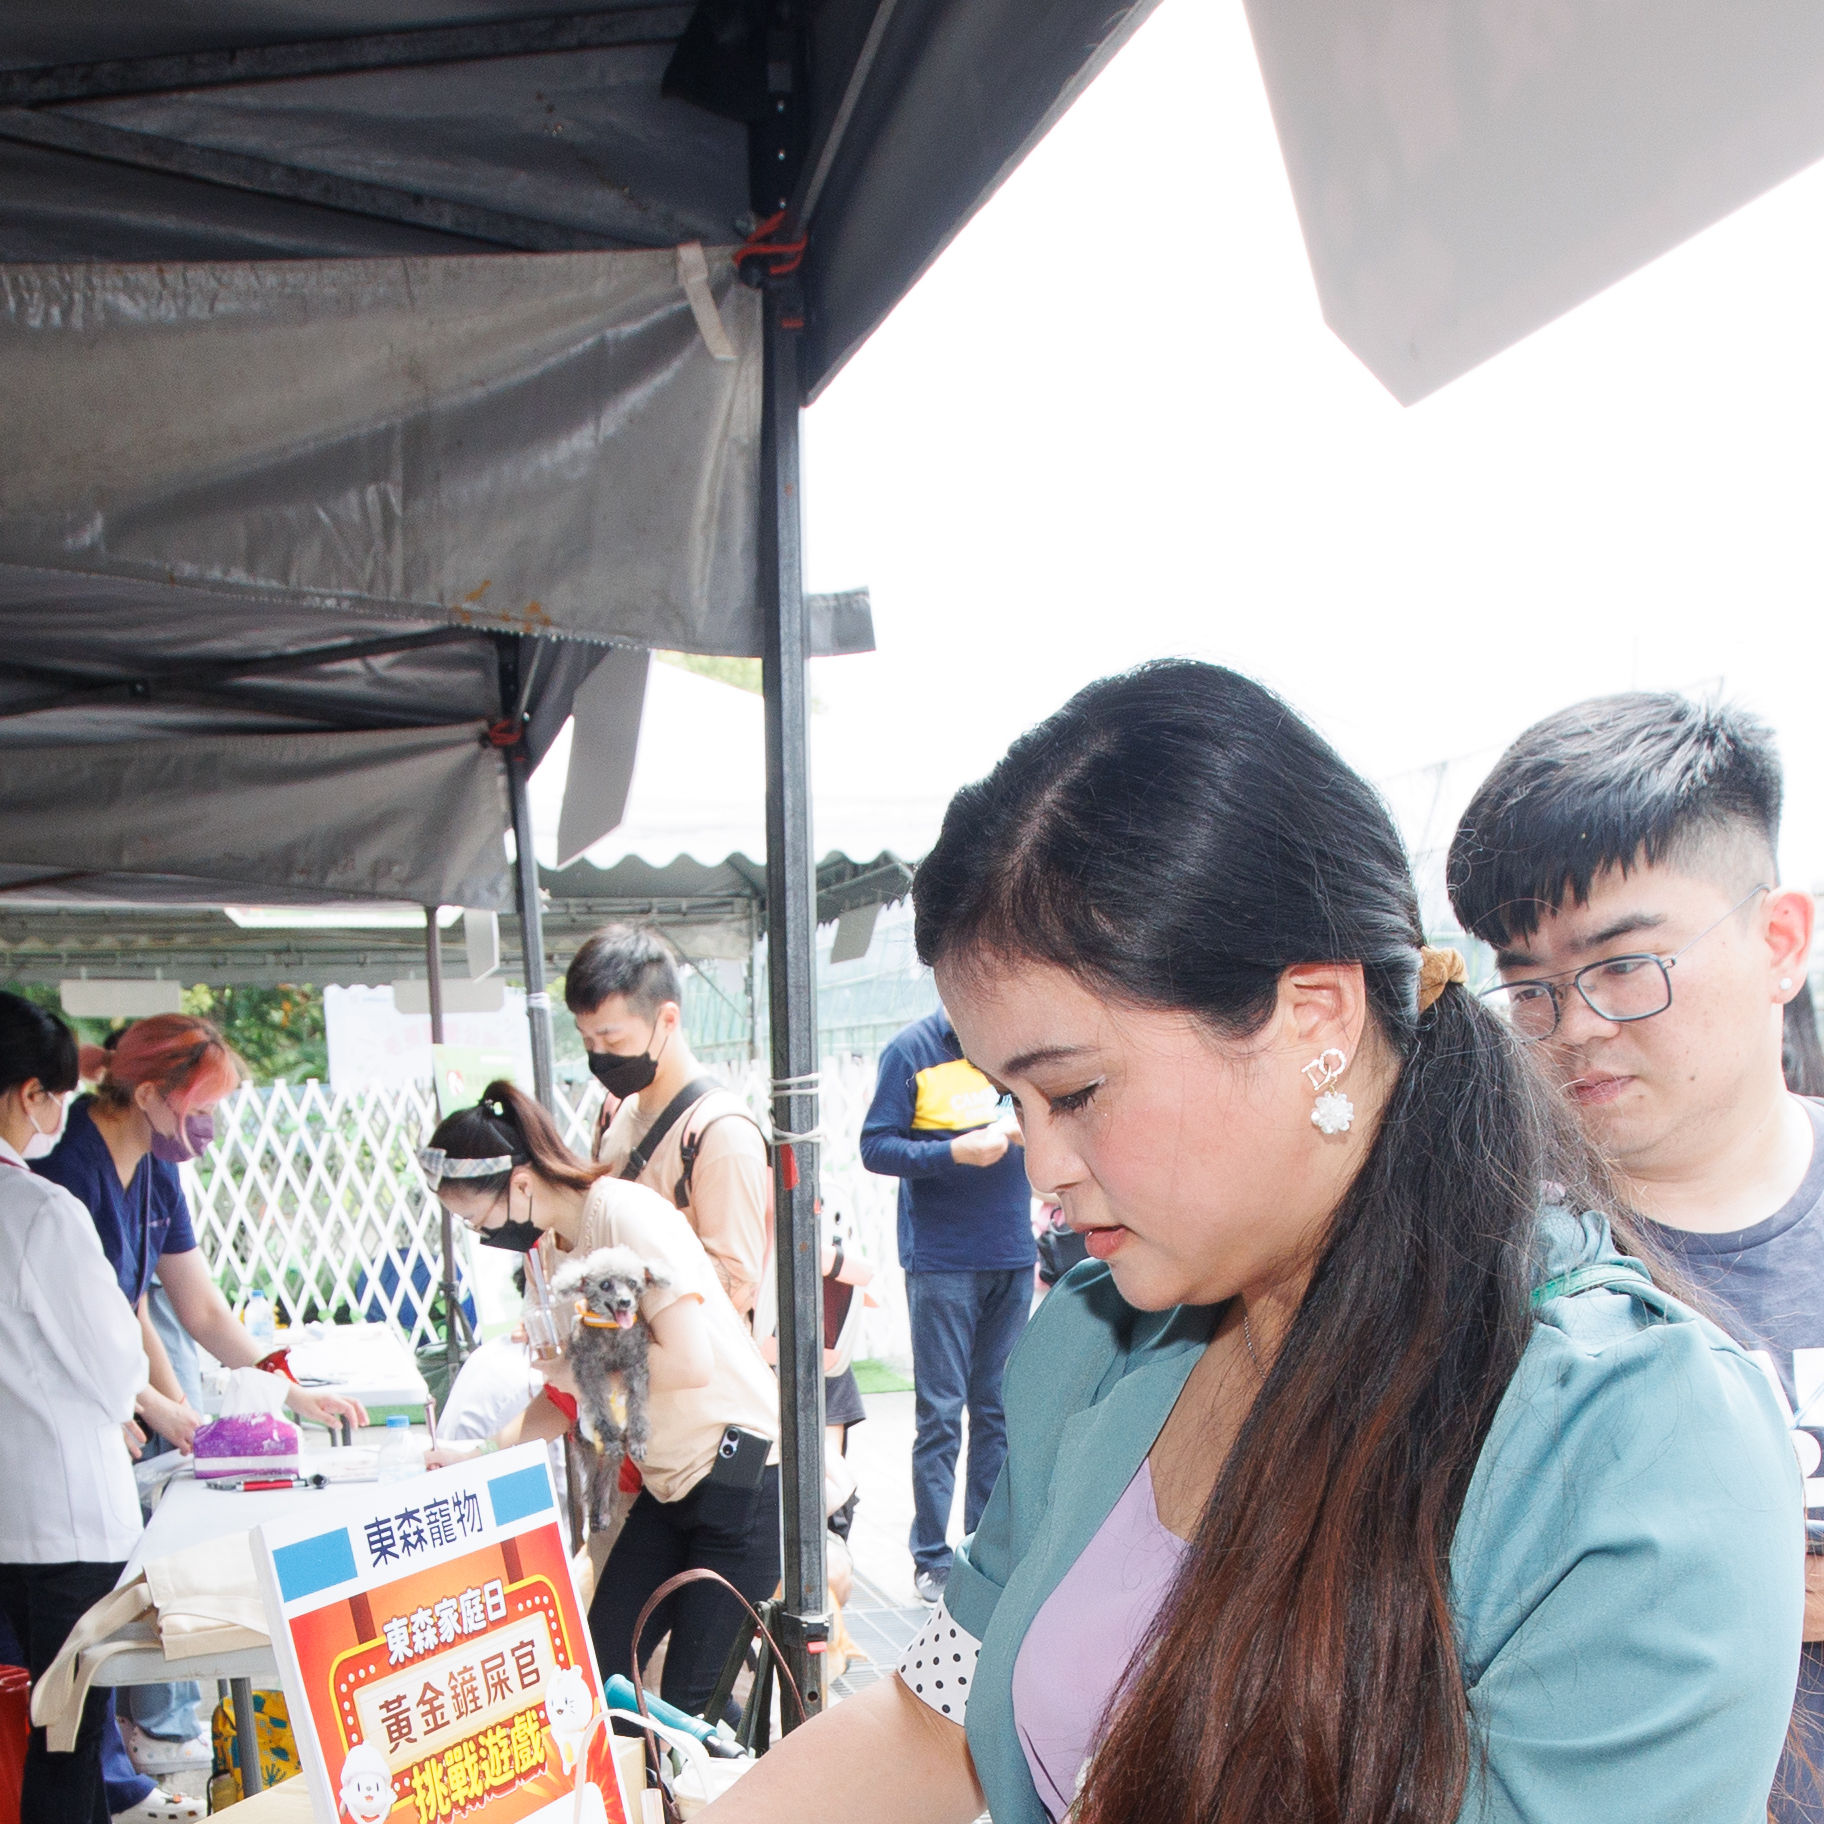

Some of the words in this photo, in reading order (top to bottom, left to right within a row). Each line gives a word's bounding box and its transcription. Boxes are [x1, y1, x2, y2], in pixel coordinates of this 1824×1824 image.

[363, 1488, 483, 1568] 東森寵物
[382, 1577, 508, 1666] 東森家庭日
[378, 1638, 541, 1755] 黃金鏟屎官
